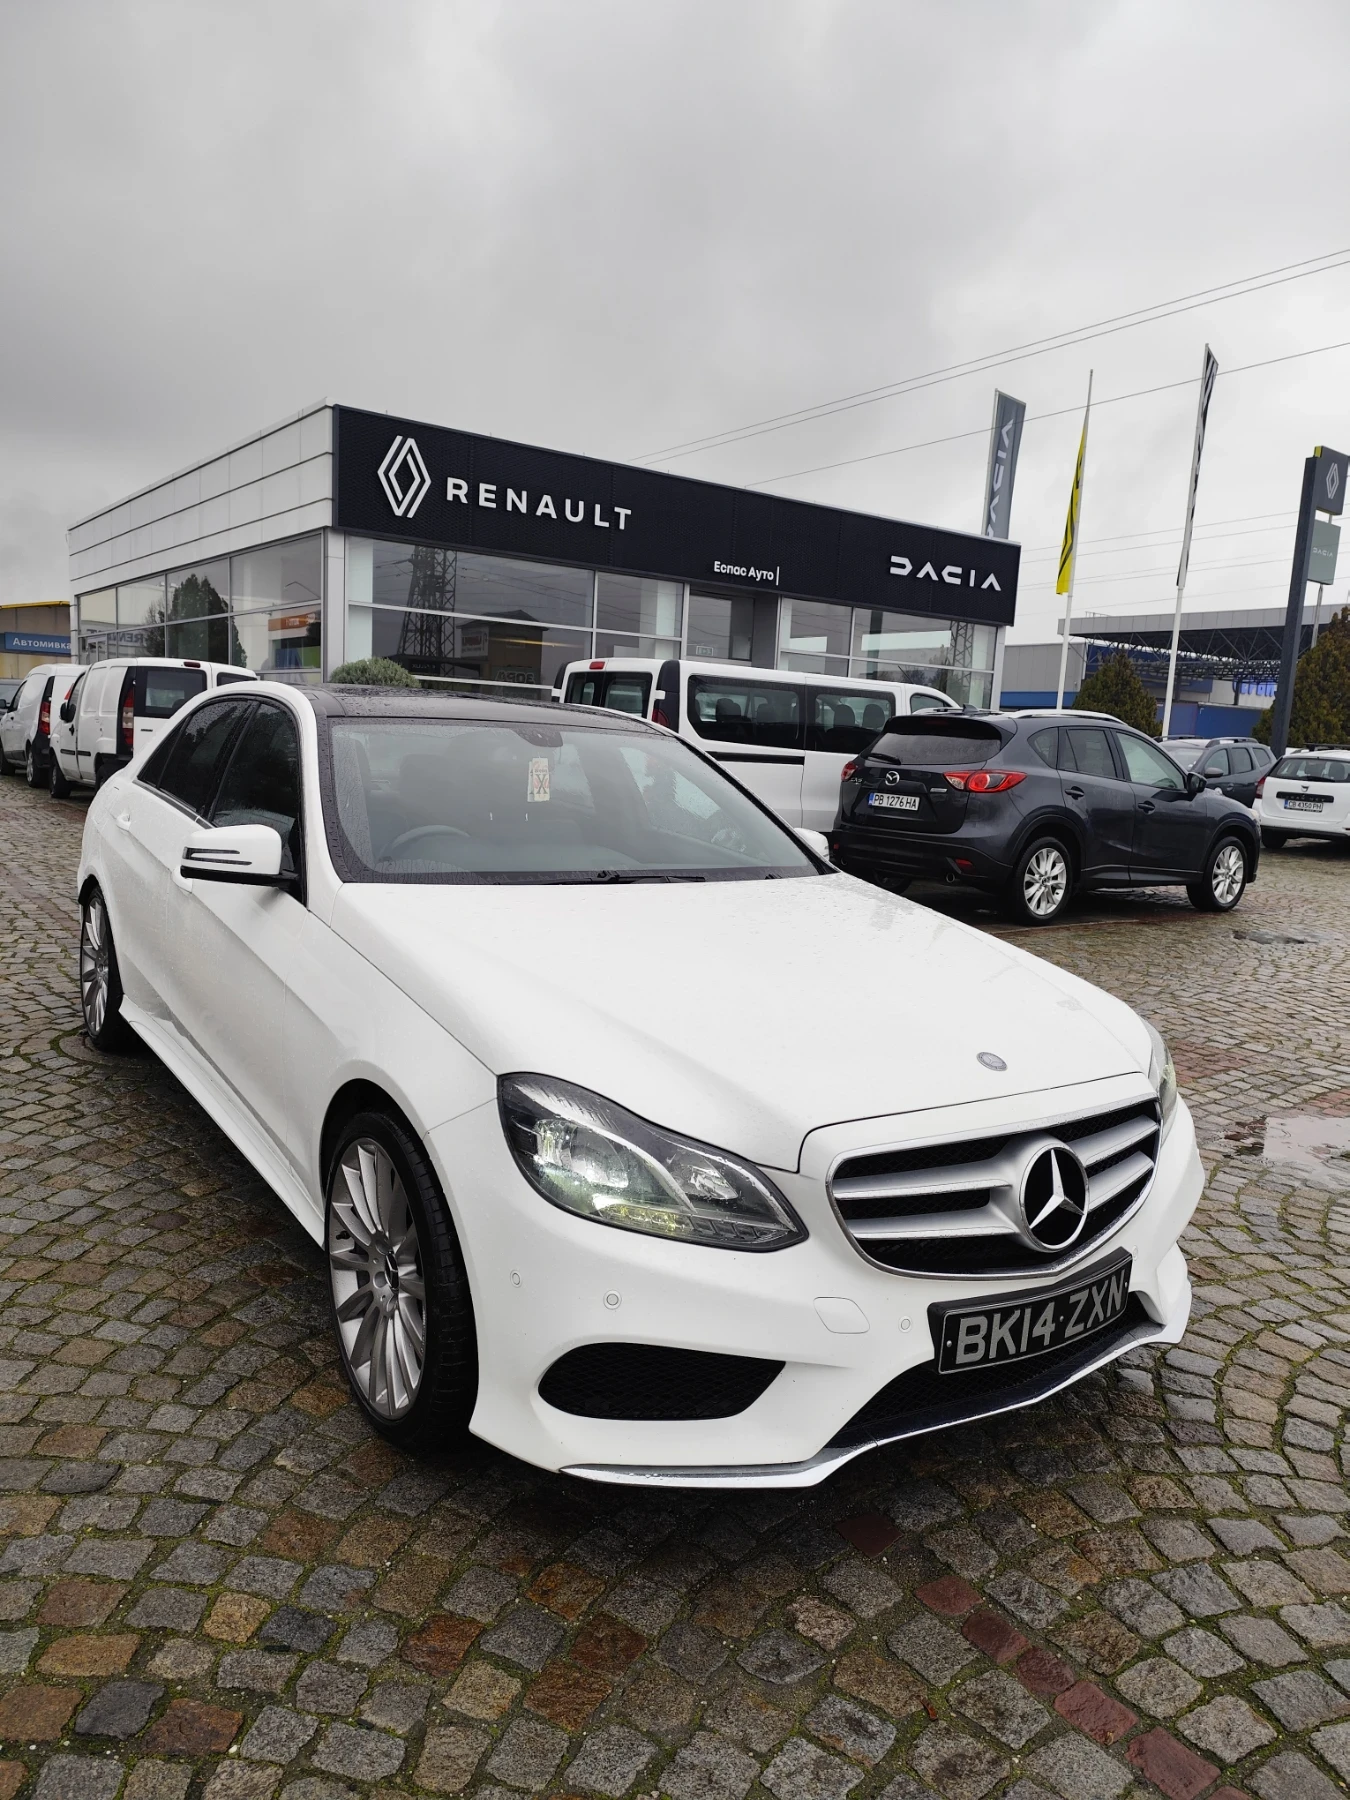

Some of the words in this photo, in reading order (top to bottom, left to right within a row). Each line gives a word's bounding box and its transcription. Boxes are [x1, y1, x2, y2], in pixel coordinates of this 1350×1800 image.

[446, 477, 632, 531] RENAULT
[1312, 547, 1333, 557] DACIA
[713, 560, 747, 576] Еспас
[747, 566, 774, 582] Ауто
[889, 555, 1002, 592] DACIA
[12, 637, 71, 650] Автомивка
[873, 794, 884, 805] PB
[886, 796, 904, 807] 1276
[905, 798, 917, 809] HA
[1289, 800, 1296, 808] CB
[955, 1302, 1055, 1364] BK14
[1064, 1269, 1126, 1338] ZXN
